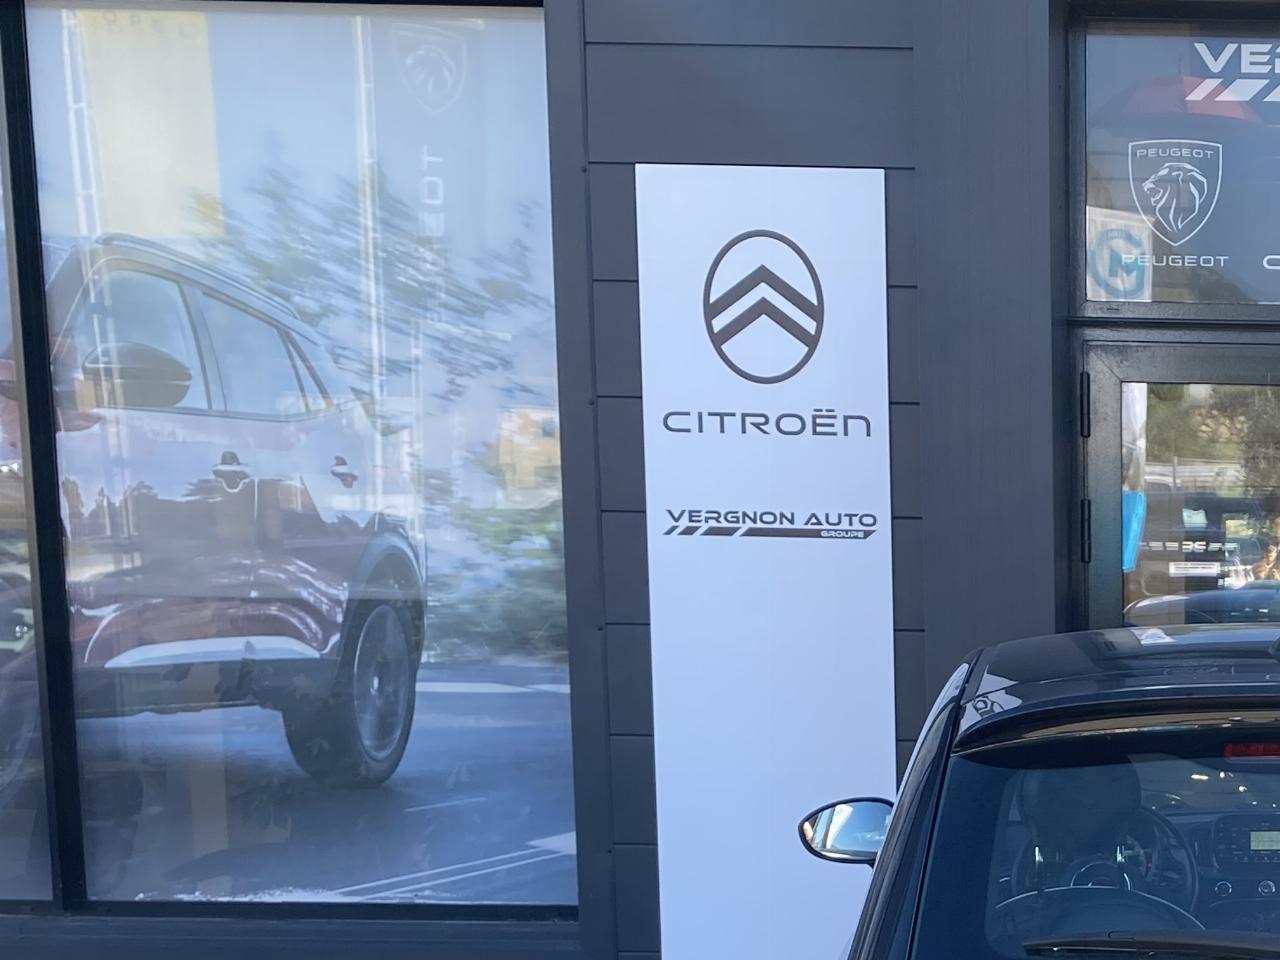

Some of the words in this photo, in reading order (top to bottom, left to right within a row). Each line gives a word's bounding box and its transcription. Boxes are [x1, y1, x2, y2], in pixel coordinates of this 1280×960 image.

[1136, 147, 1214, 159] PEUGEOT
[1121, 254, 1229, 267] PEUGEOT
[666, 509, 795, 525] VERGNON
[804, 513, 877, 527] AUTO
[821, 530, 865, 538] GROUPE
